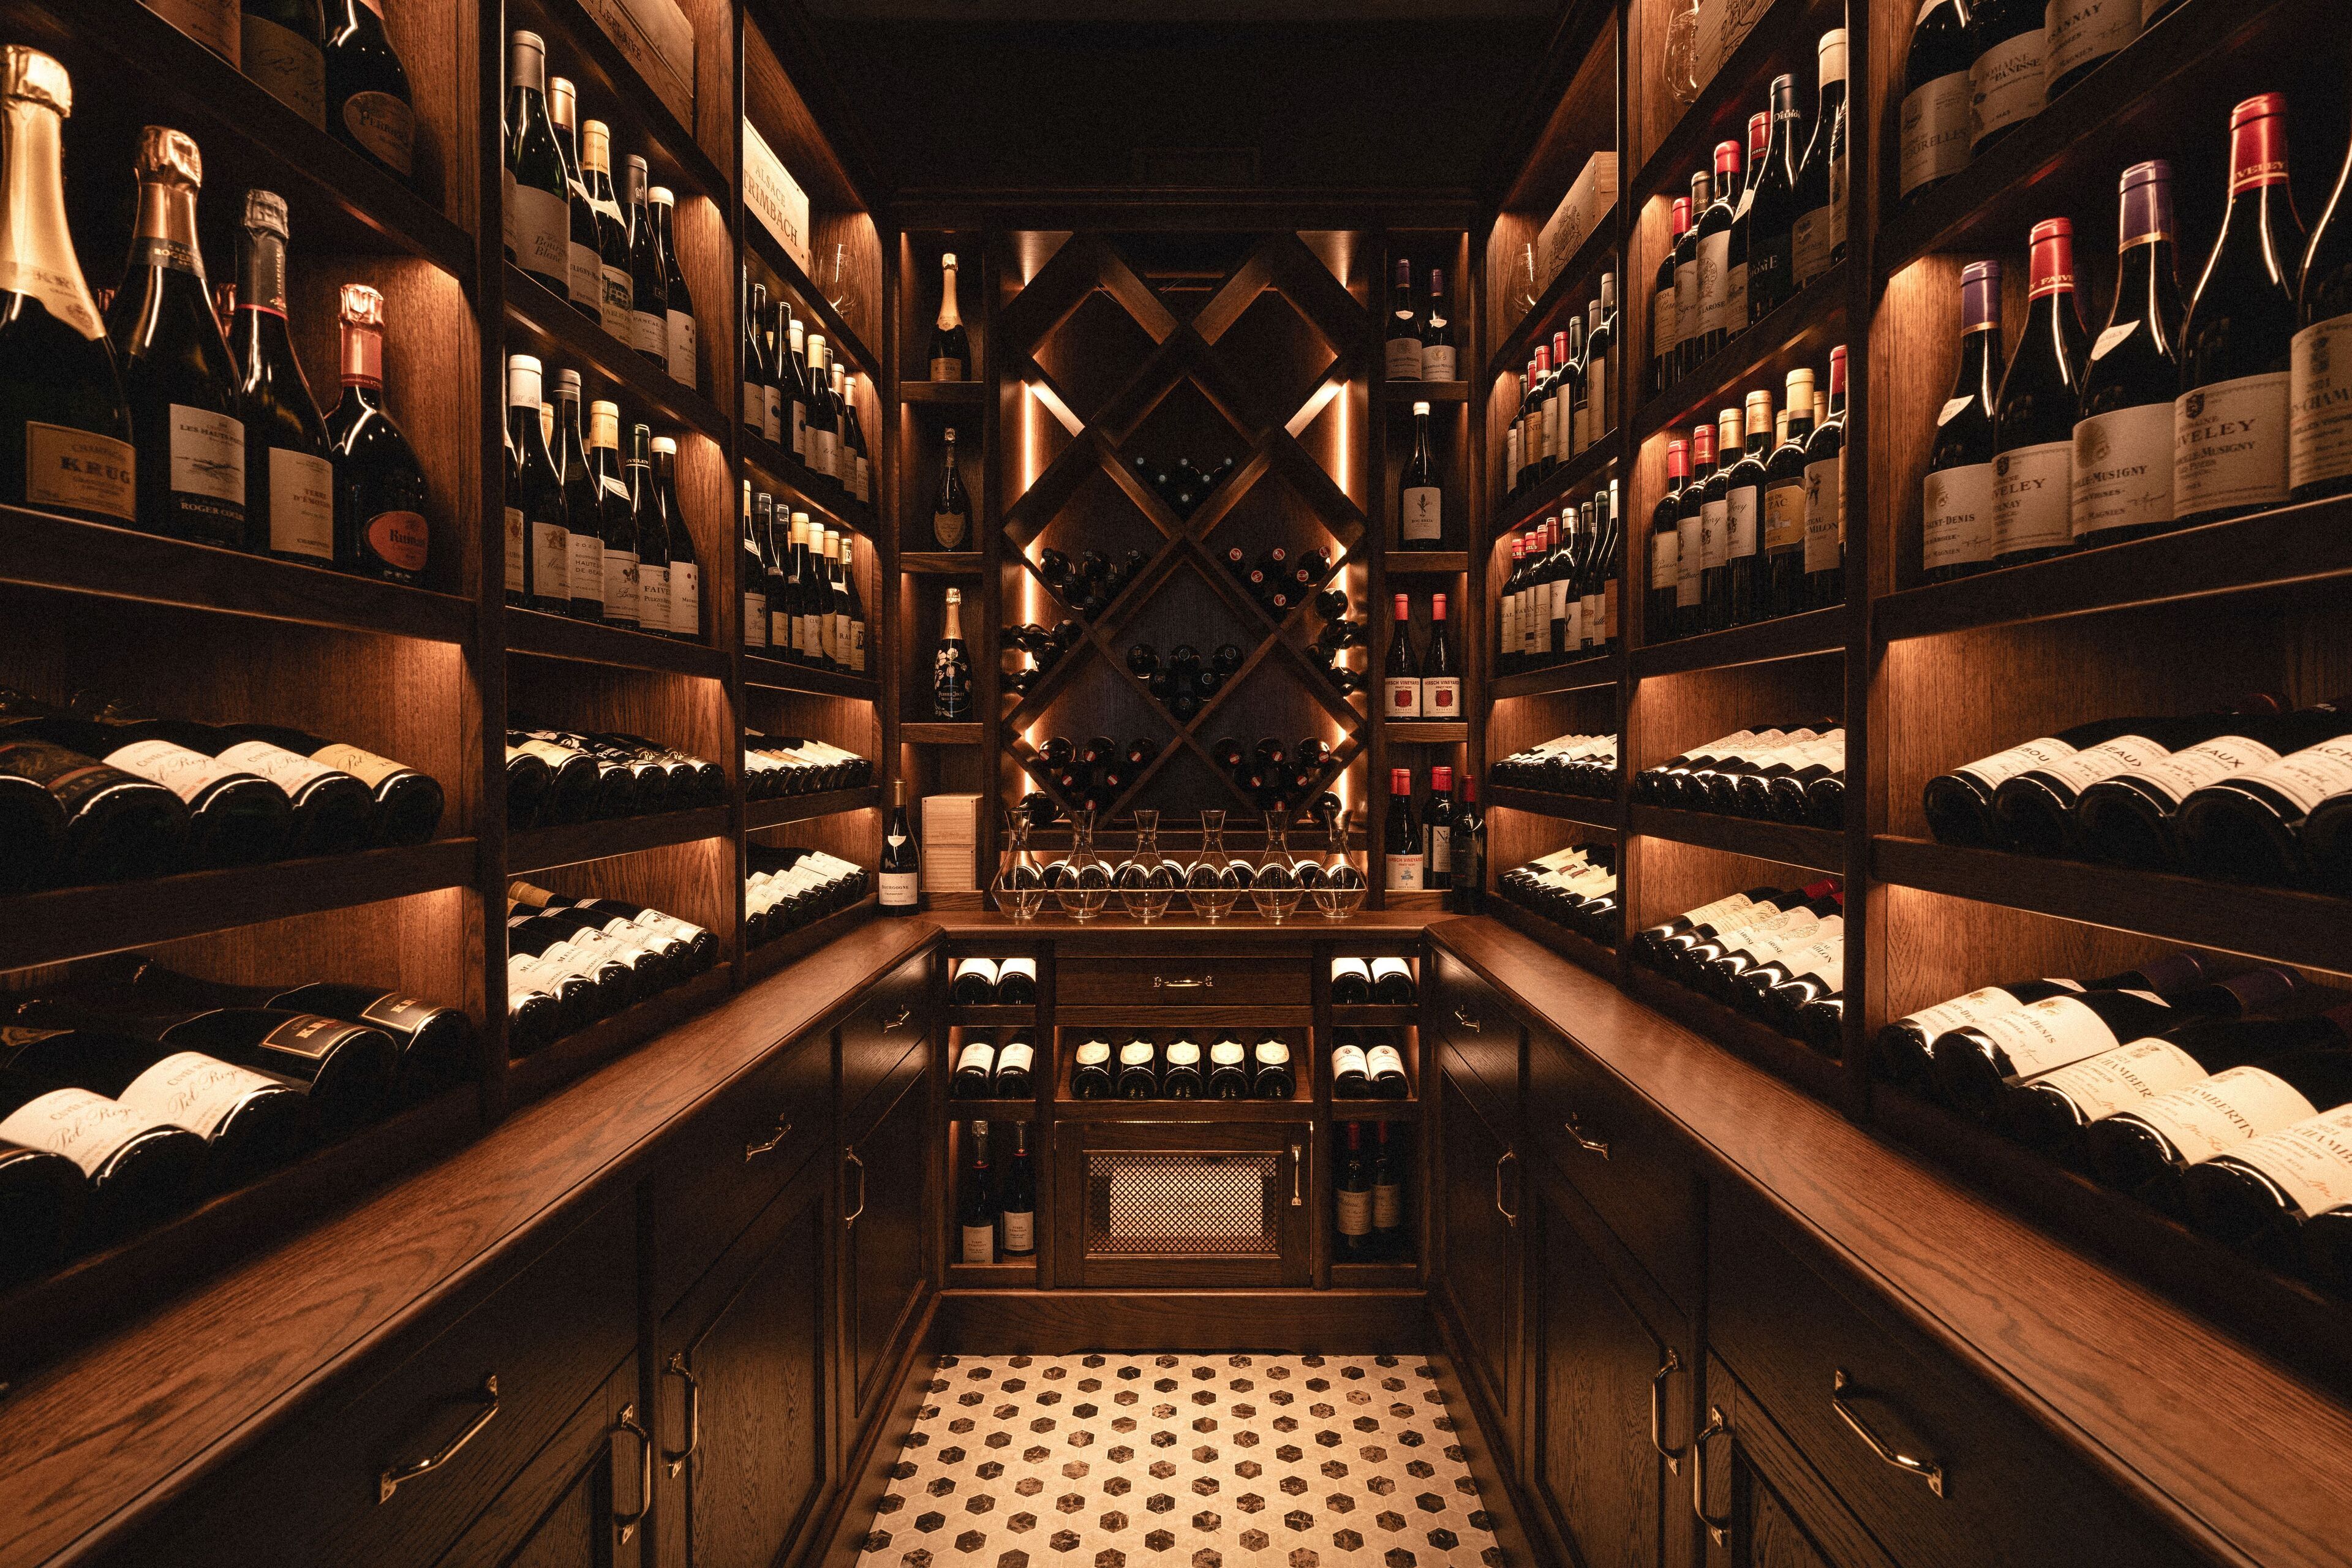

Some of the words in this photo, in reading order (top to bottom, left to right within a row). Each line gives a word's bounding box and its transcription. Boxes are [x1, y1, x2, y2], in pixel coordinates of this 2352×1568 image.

[755, 165, 786, 208] ALSACE
[744, 168, 797, 247] TRIMBACH
[1702, 301, 1725, 314] LAROSE
[60, 456, 131, 484] KRUG
[179, 502, 219, 516] ROGER
[1656, 559, 1677, 573] Gazin
